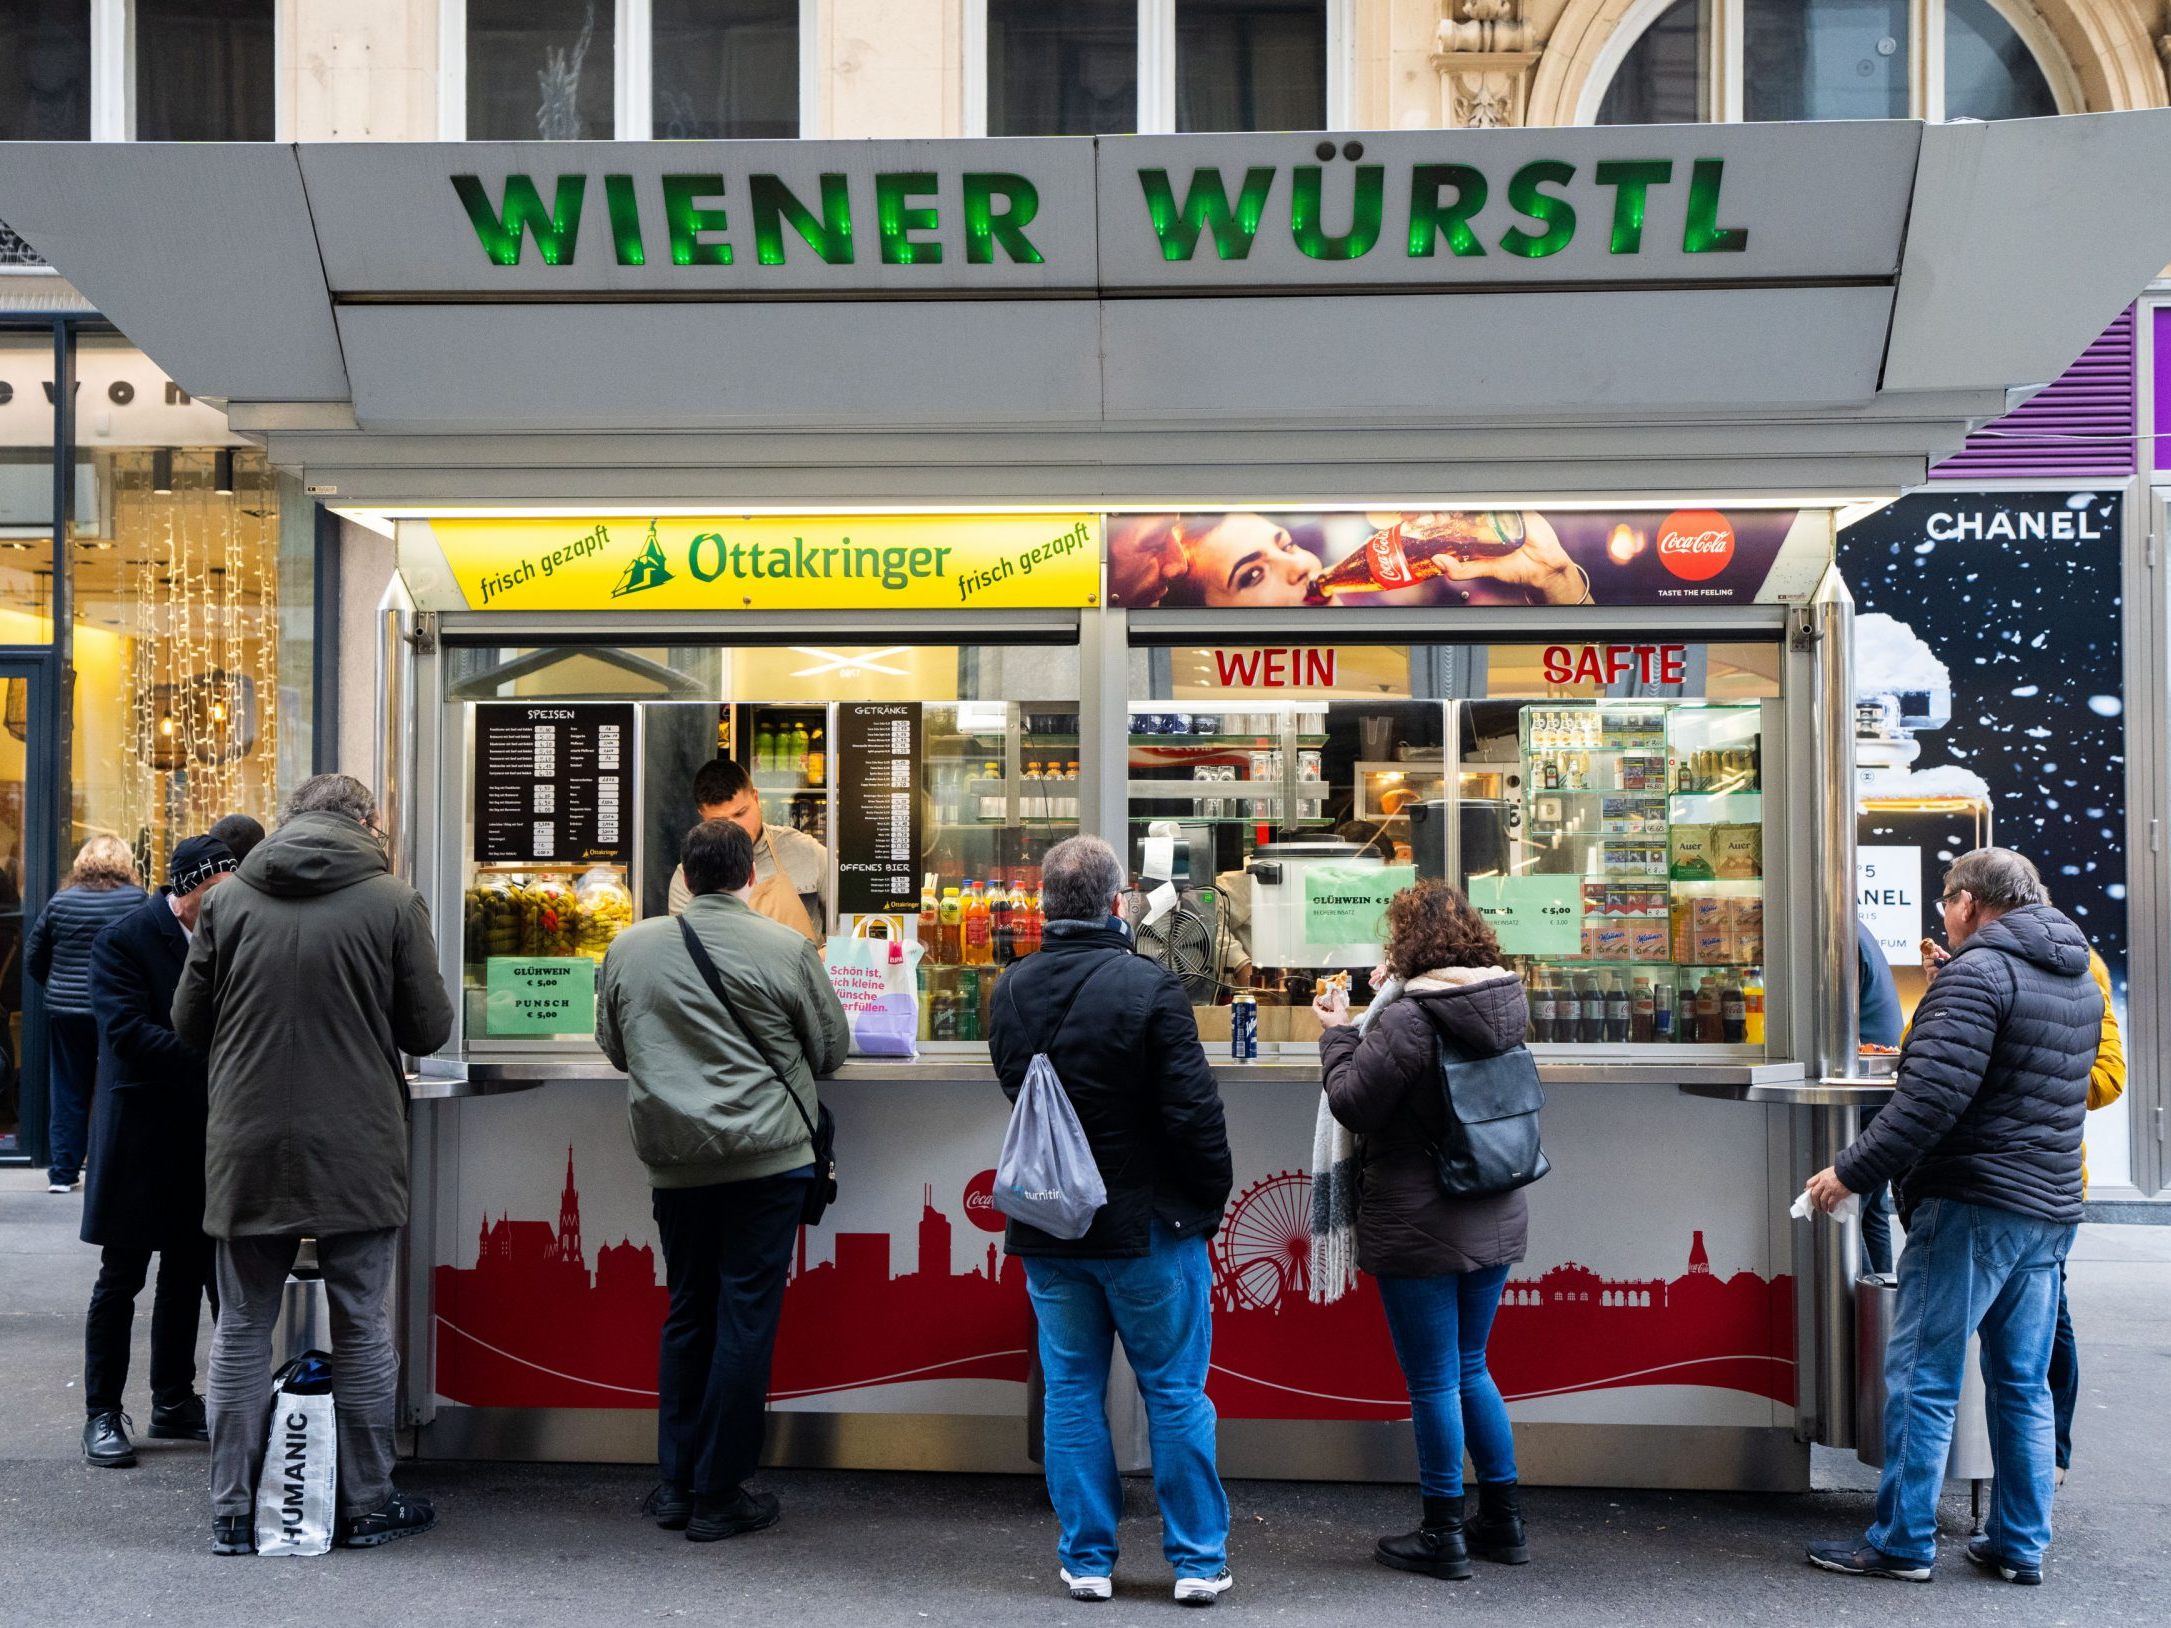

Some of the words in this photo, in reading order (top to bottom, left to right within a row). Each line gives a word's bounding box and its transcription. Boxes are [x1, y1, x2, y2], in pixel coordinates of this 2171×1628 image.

[450, 172, 1045, 265] WIENER
[1137, 140, 1749, 261] WÜRSTL
[1926, 511, 2101, 541] CHANEL
[1660, 530, 1731, 554] Coca-Cola
[480, 559, 536, 605] frisch
[541, 524, 610, 577] gezapft
[688, 533, 952, 590] Ottakringer
[958, 556, 1014, 602] frisch
[1019, 521, 1090, 575] gezapft
[1657, 589, 1682, 597] TASTE
[1700, 588, 1734, 596] FEELING
[1215, 648, 1335, 687] WEIN
[527, 709, 575, 720] SPEISEN
[854, 704, 908, 715] GETRÄNKE
[1680, 842, 1702, 850] Auer
[1728, 841, 1751, 850] Auer
[840, 863, 882, 872] OFFENES
[885, 863, 910, 872] BIER
[1313, 894, 1371, 904] GLÜHWEIN
[1857, 889, 1911, 905] NEL
[1550, 907, 1571, 915] 5,00
[1876, 940, 1907, 948] FUM
[513, 966, 571, 976] GLÜHWEIN
[831, 965, 863, 976] Schön
[866, 967, 882, 979] ist,
[537, 979, 558, 988] 5,00
[852, 978, 875, 990] kleine
[515, 999, 569, 1008] PUNSCH
[842, 1001, 888, 1012] erfüllen.
[537, 1011, 558, 1020] 5,00
[280, 1412, 309, 1546] HUMANIC
